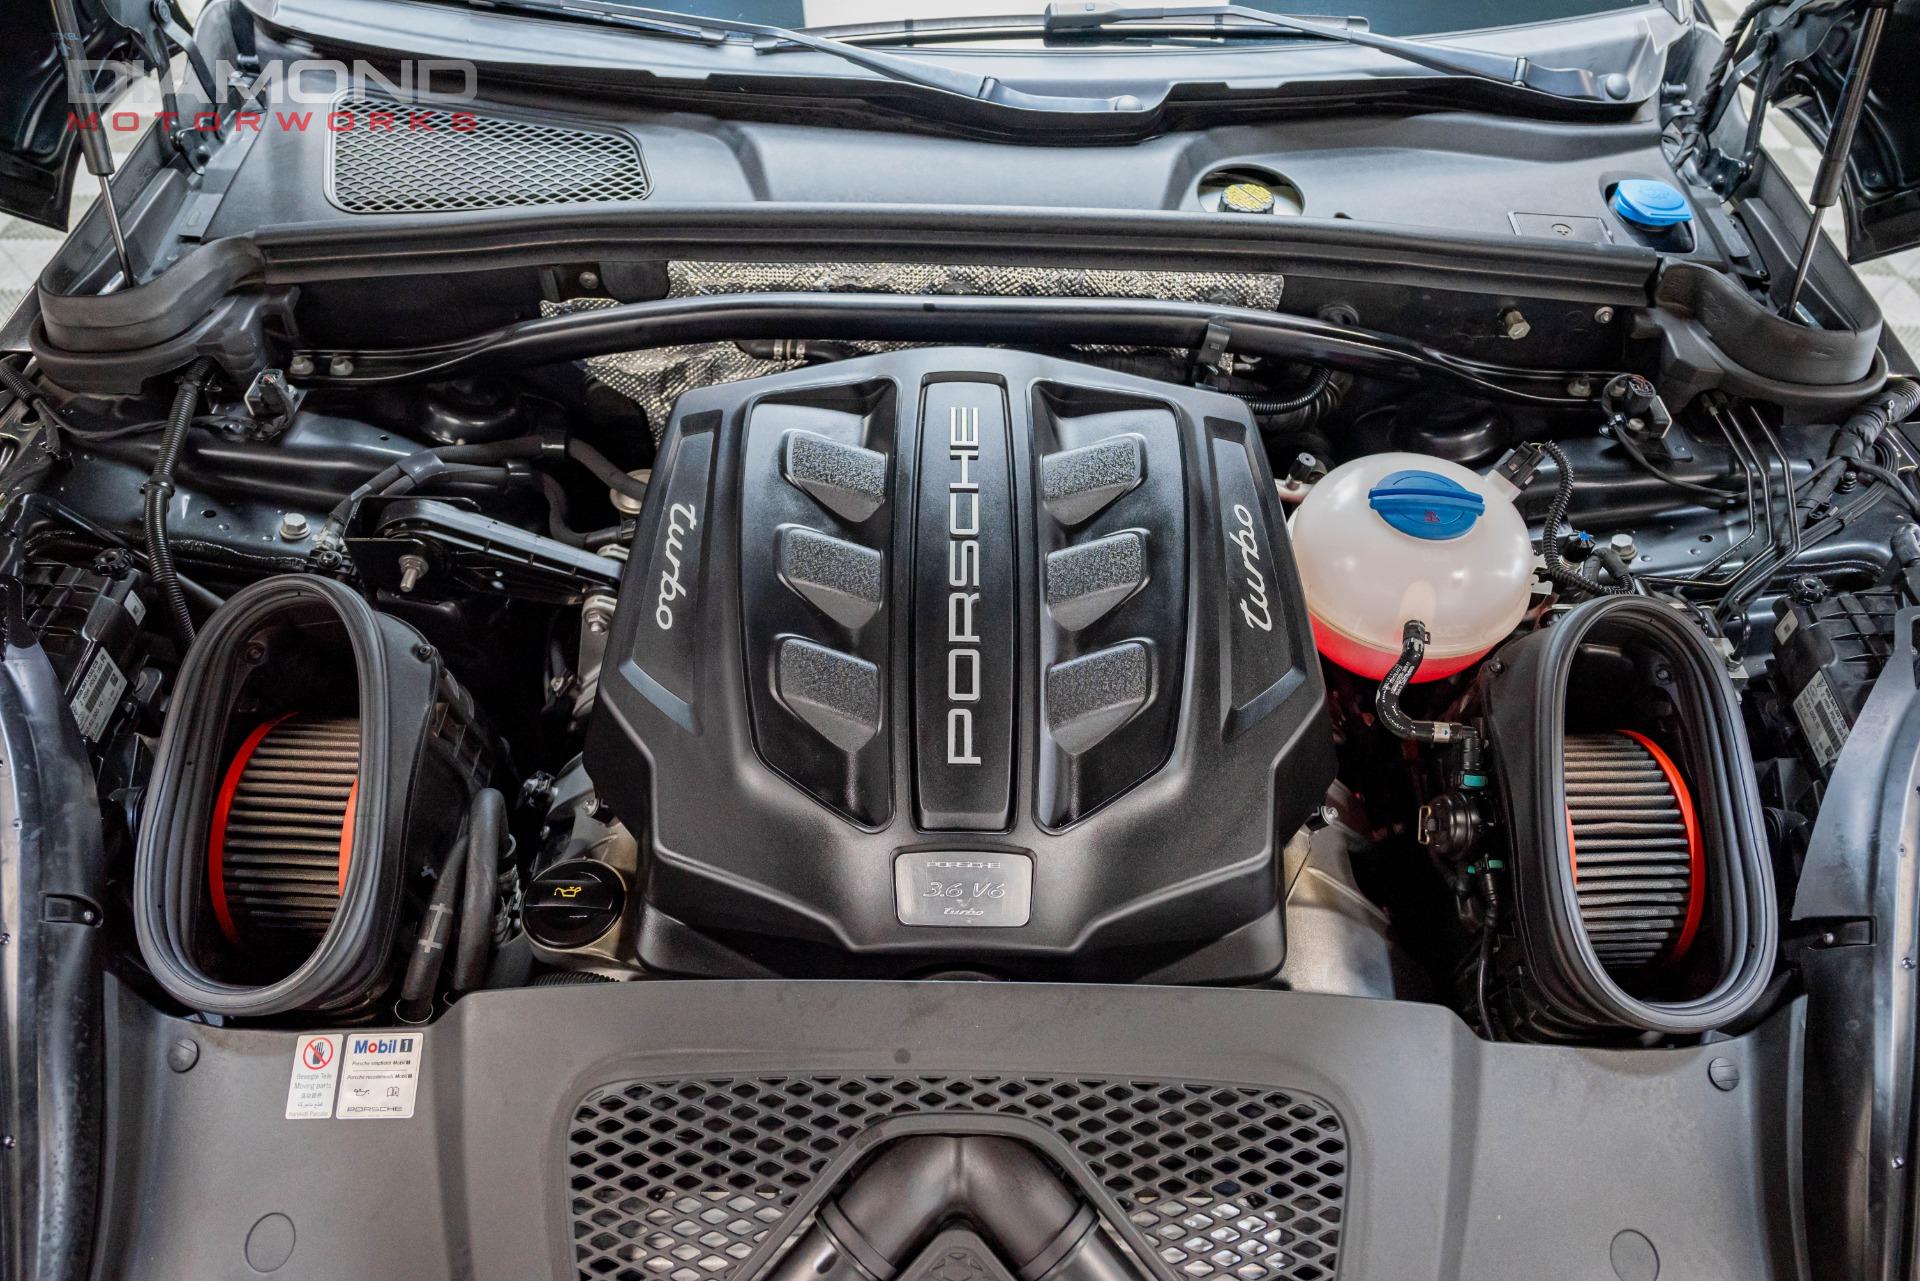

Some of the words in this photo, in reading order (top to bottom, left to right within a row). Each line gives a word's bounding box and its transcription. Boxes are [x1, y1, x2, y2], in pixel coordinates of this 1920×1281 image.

[657, 502, 697, 631] turbo
[1234, 503, 1273, 632] turbo
[947, 406, 981, 765] PORSCHE
[927, 861, 1001, 869] PORSCHE
[923, 881, 963, 898] 3.6
[972, 882, 1005, 899] V6
[943, 907, 984, 916] turbo
[354, 1039, 397, 1054] Mobil
